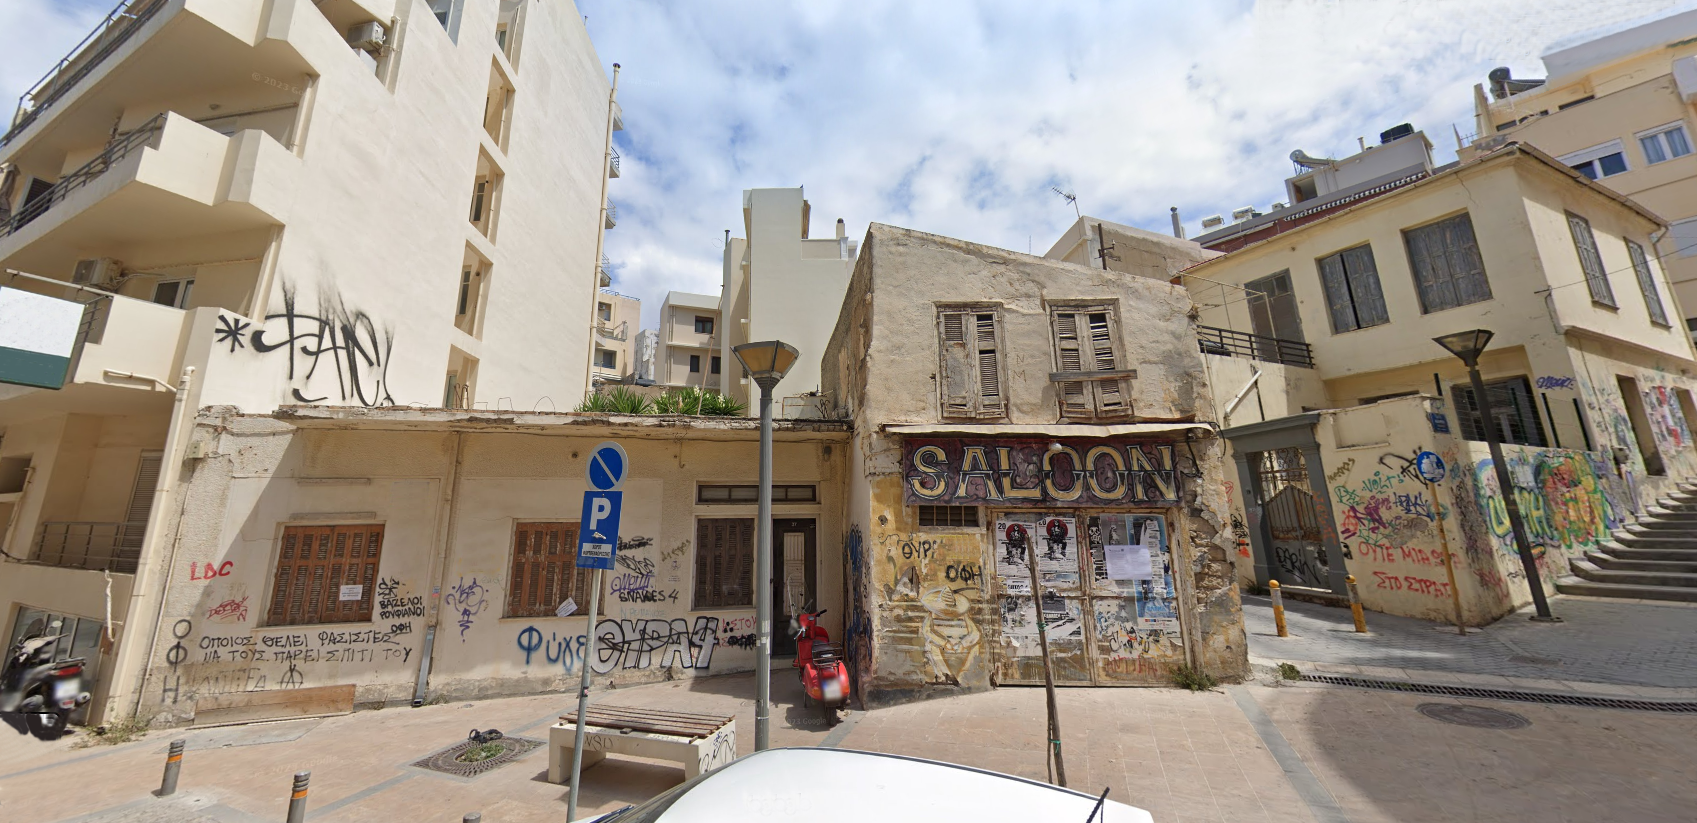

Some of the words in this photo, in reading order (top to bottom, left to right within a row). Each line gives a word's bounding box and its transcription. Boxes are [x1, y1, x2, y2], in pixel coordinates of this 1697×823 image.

[908, 444, 1180, 502] SALOON
[590, 498, 611, 530] P
[668, 589, 679, 604] 4
[199, 635, 258, 650] ΟΠΟΙΟΣ
[262, 632, 308, 648] ΘΕΛΕΙ
[317, 630, 400, 647] ΦΑΣΙΣΤΕΣ
[382, 647, 412, 664] ΤΟΥ
